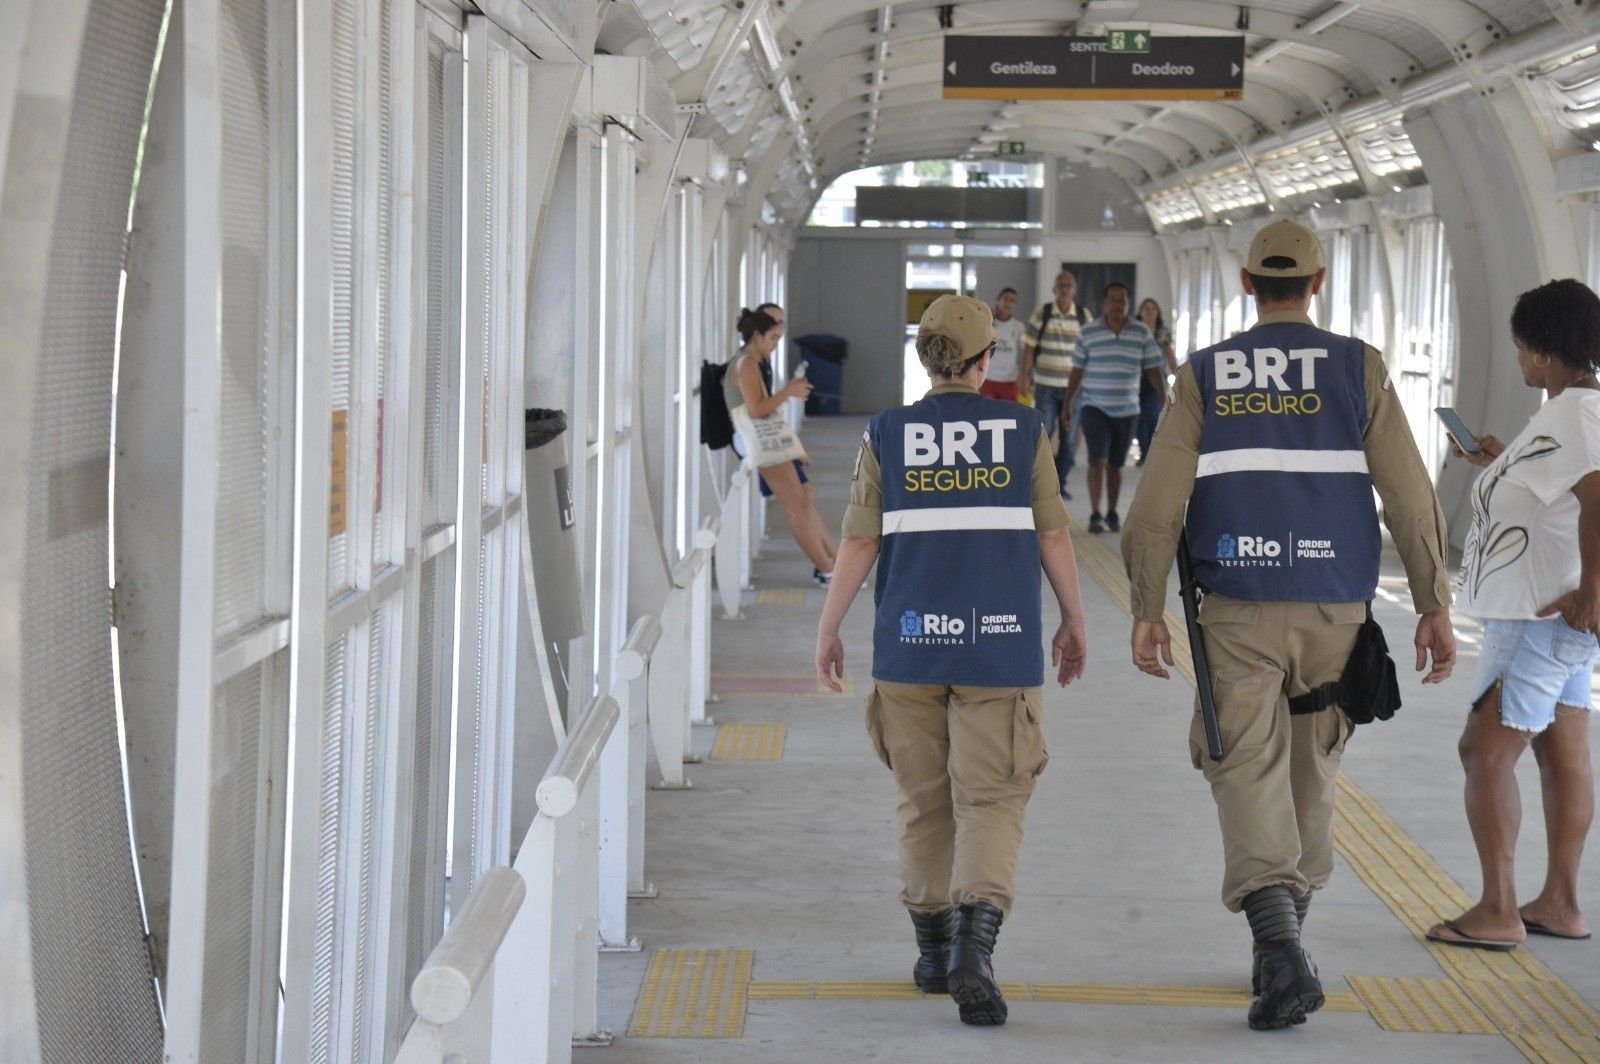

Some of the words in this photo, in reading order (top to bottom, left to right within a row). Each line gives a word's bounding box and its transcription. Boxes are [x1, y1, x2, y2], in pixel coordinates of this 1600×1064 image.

[990, 62, 1057, 75] Gentileza
[1131, 62, 1195, 75] Deodoro
[1214, 348, 1328, 392] BRT
[1215, 392, 1322, 417] SEGURO
[904, 419, 1017, 466] BRT
[905, 465, 1011, 492] SEGURO
[1238, 536, 1281, 557] Rio
[1297, 539, 1331, 548] ORDEM
[1297, 547, 1336, 559] PÚBLICA
[1218, 559, 1281, 567] REFEITURA
[923, 613, 965, 636] Rio
[981, 614, 1017, 624] ORDEM
[981, 622, 1022, 634] PÚBLICA
[900, 636, 964, 645] PREFEITURA
